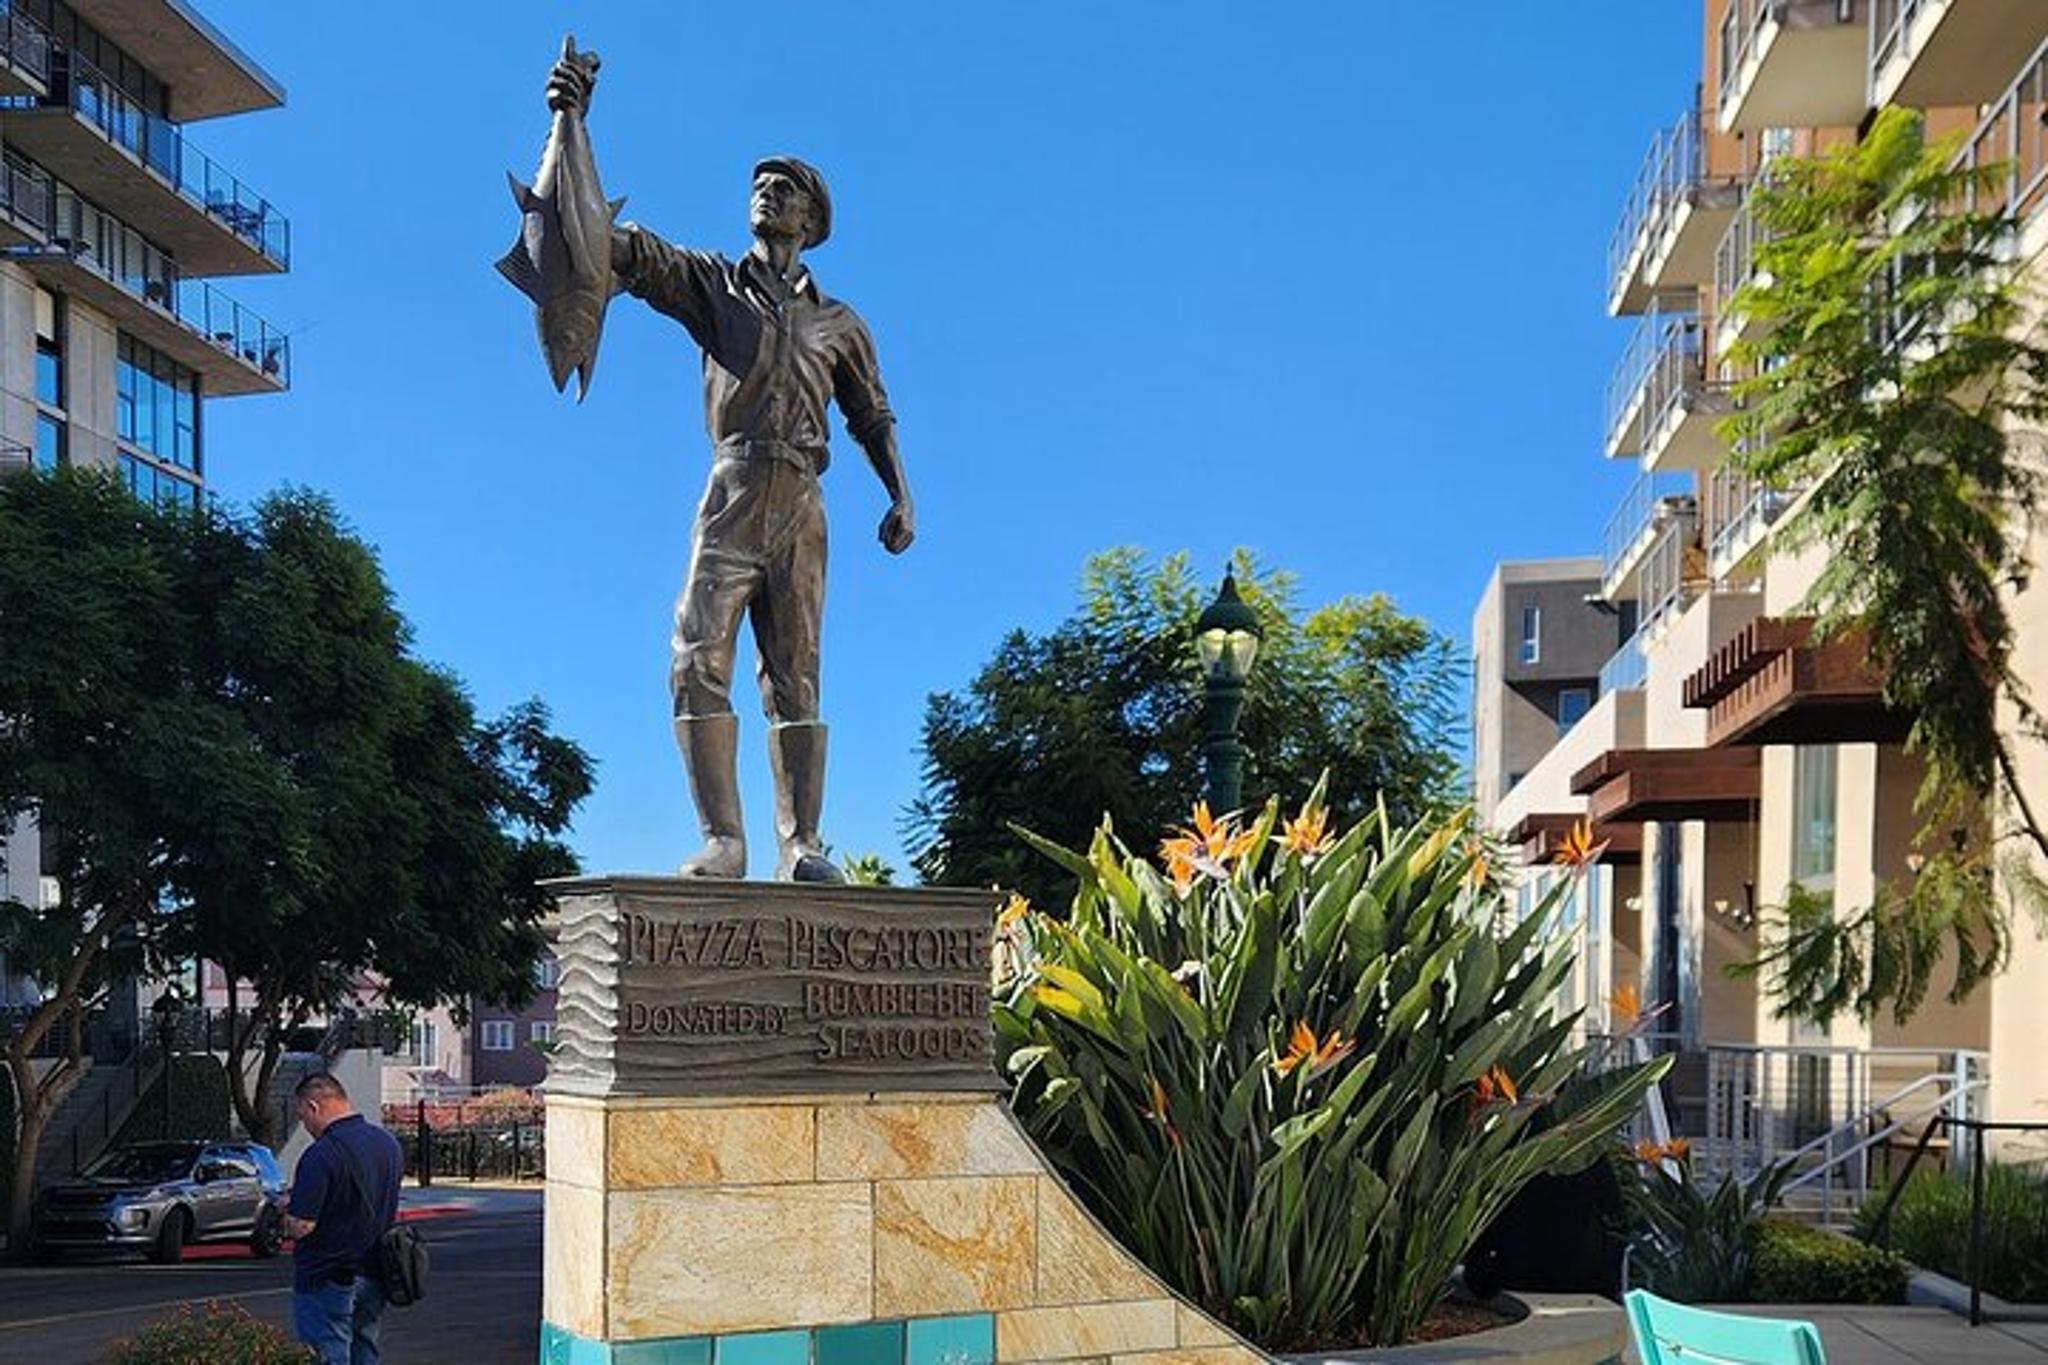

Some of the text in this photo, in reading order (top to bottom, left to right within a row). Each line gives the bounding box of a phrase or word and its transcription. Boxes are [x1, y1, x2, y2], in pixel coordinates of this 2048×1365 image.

[622, 911, 990, 972] PIAZZA PESCATORE
[625, 1000, 790, 1036] DONATED BY
[803, 982, 984, 1020] BUMBLE BEE
[815, 1021, 986, 1064] SEAFOODS
